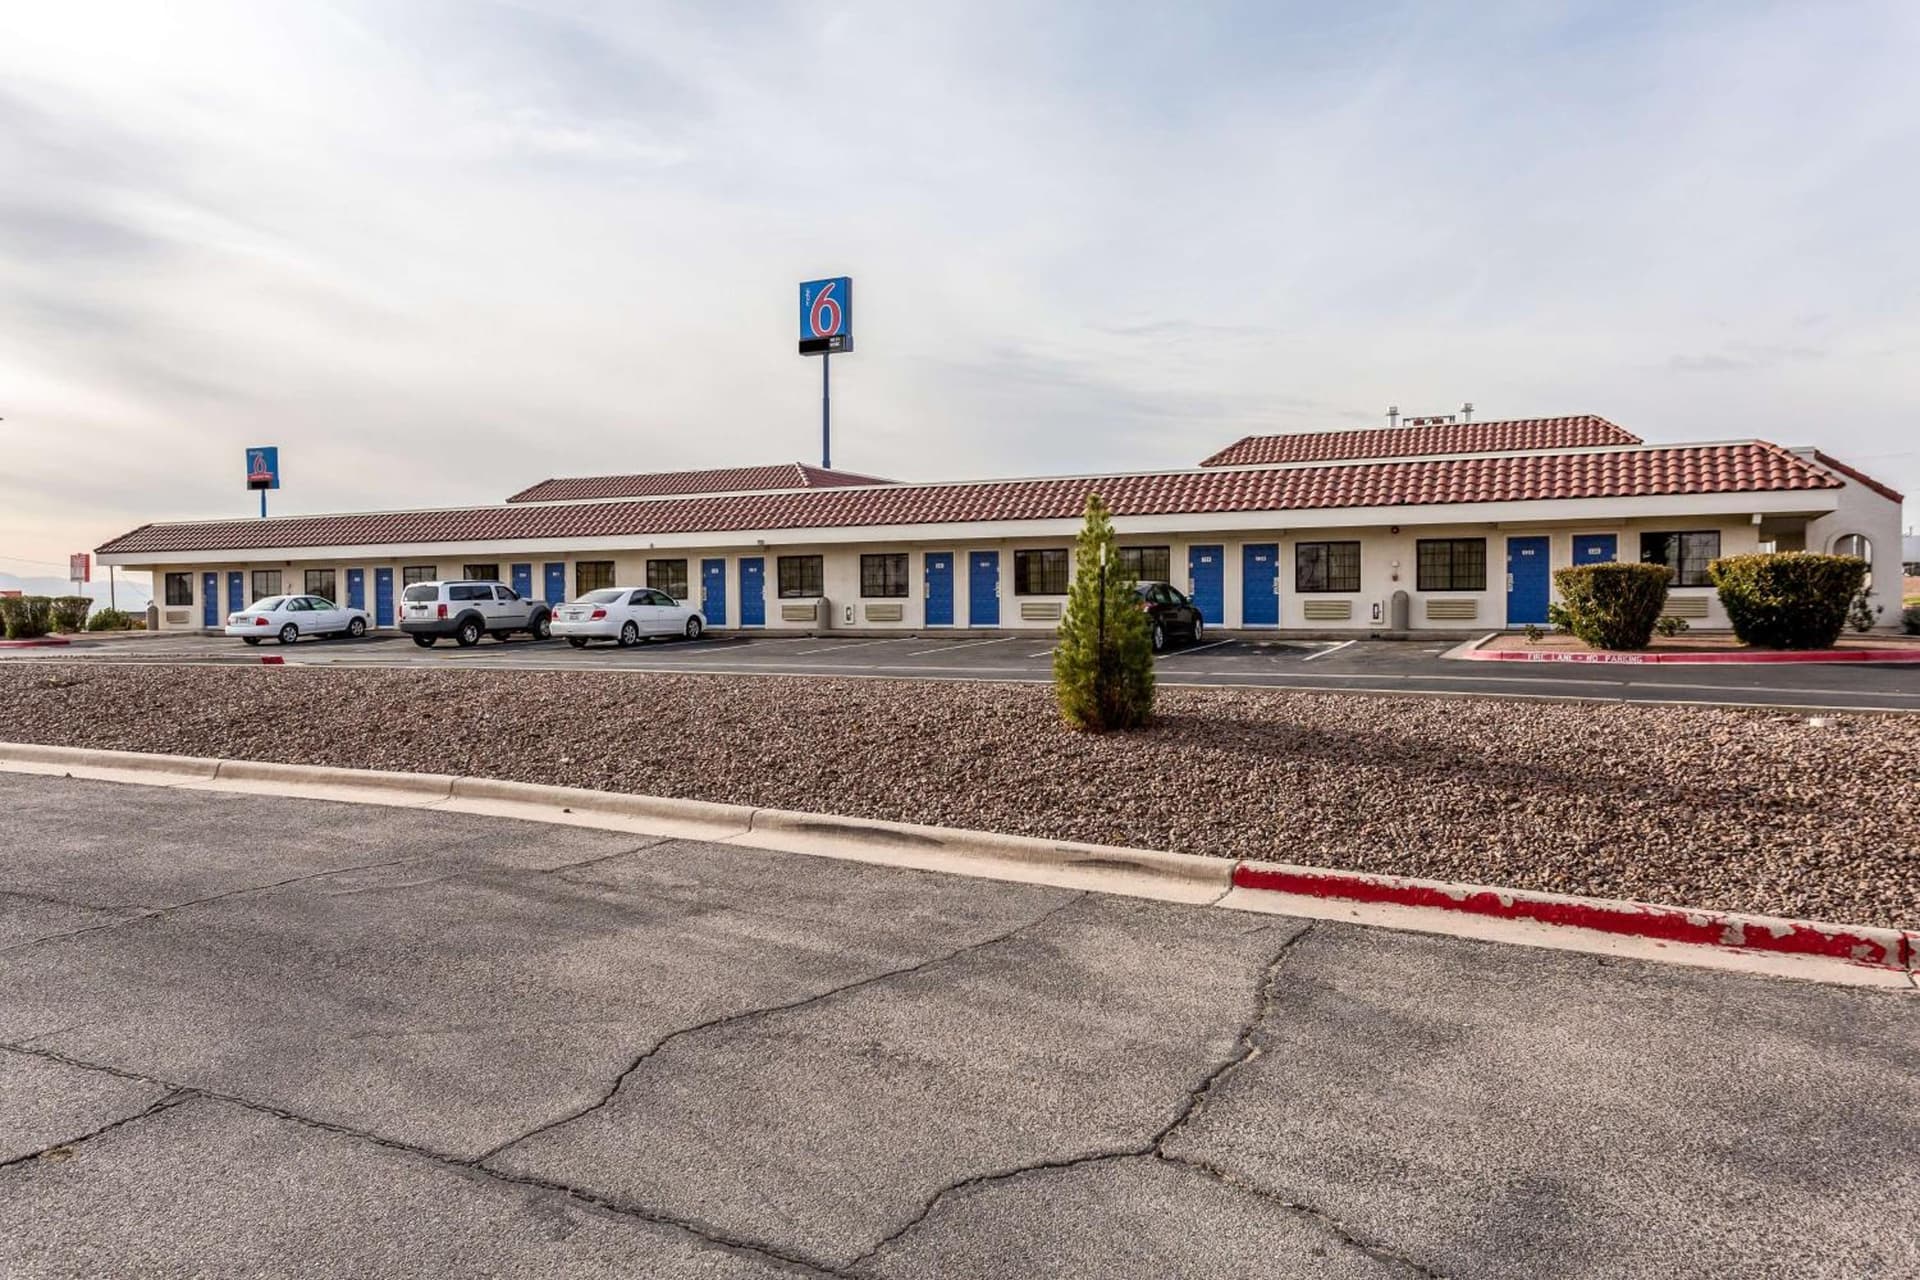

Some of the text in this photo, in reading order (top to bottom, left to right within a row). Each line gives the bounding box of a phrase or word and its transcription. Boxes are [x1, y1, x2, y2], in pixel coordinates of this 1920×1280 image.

[810, 282, 842, 338] 6
[1586, 654, 1598, 663] NO
[1605, 655, 1643, 664] PARKING
